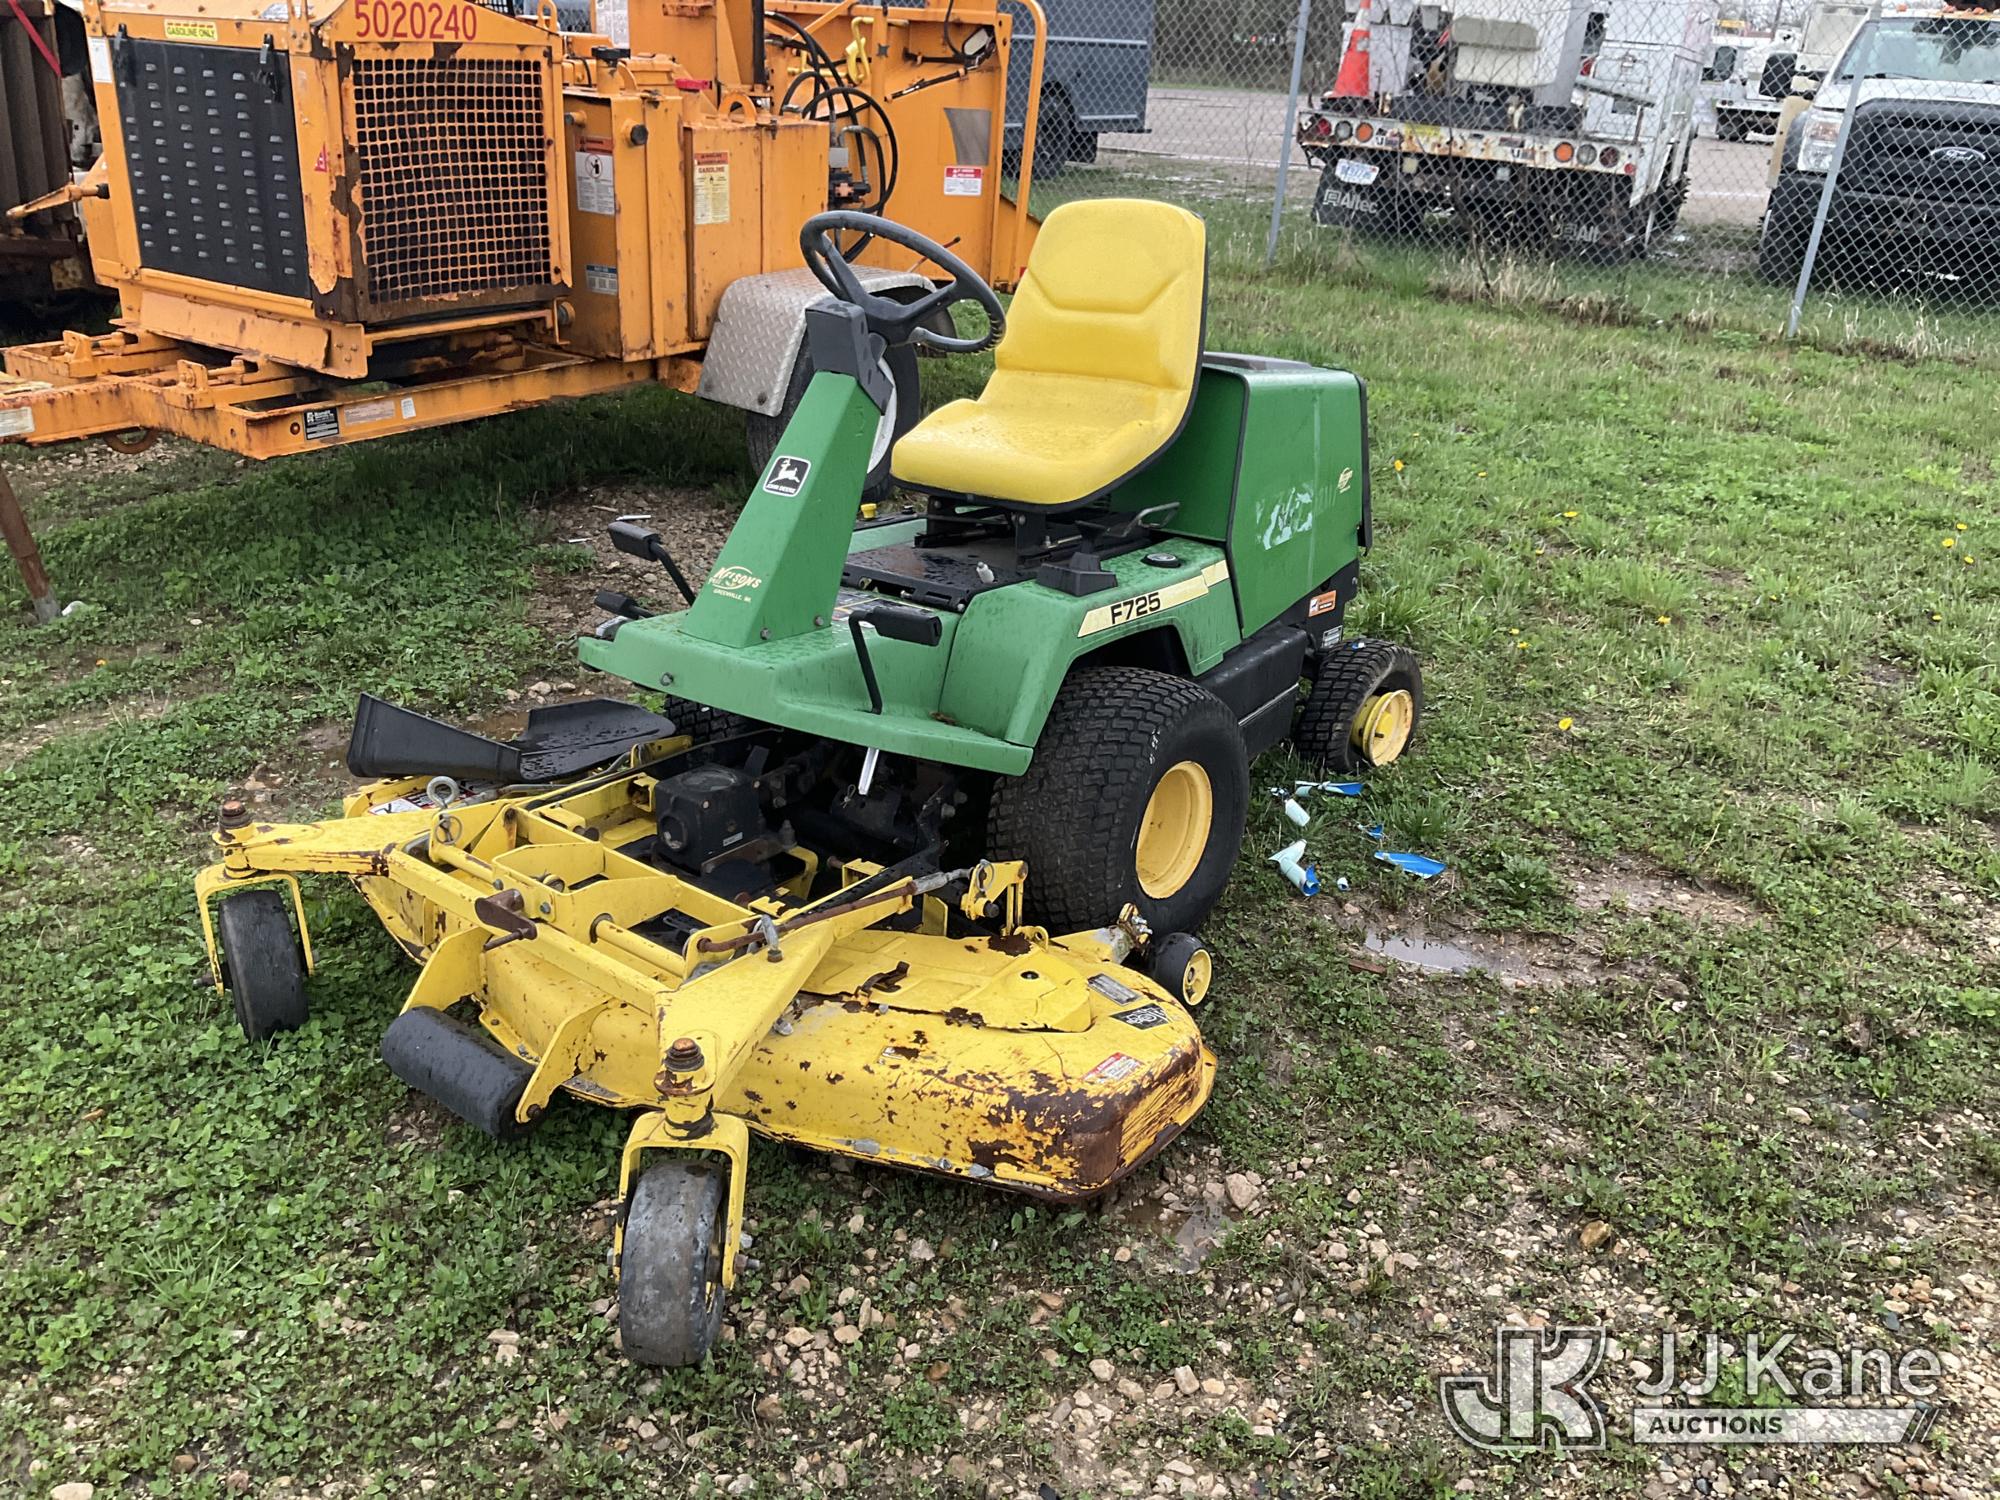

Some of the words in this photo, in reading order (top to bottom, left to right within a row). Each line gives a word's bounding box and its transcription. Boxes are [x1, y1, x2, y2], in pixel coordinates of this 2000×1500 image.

[354, 0, 477, 40] 5020240
[167, 26, 198, 37] GASOLINE
[199, 28, 215, 38] ONLY
[1340, 192, 1378, 213] Altec
[779, 485, 797, 493] DEERE
[1110, 592, 1161, 624] F725
